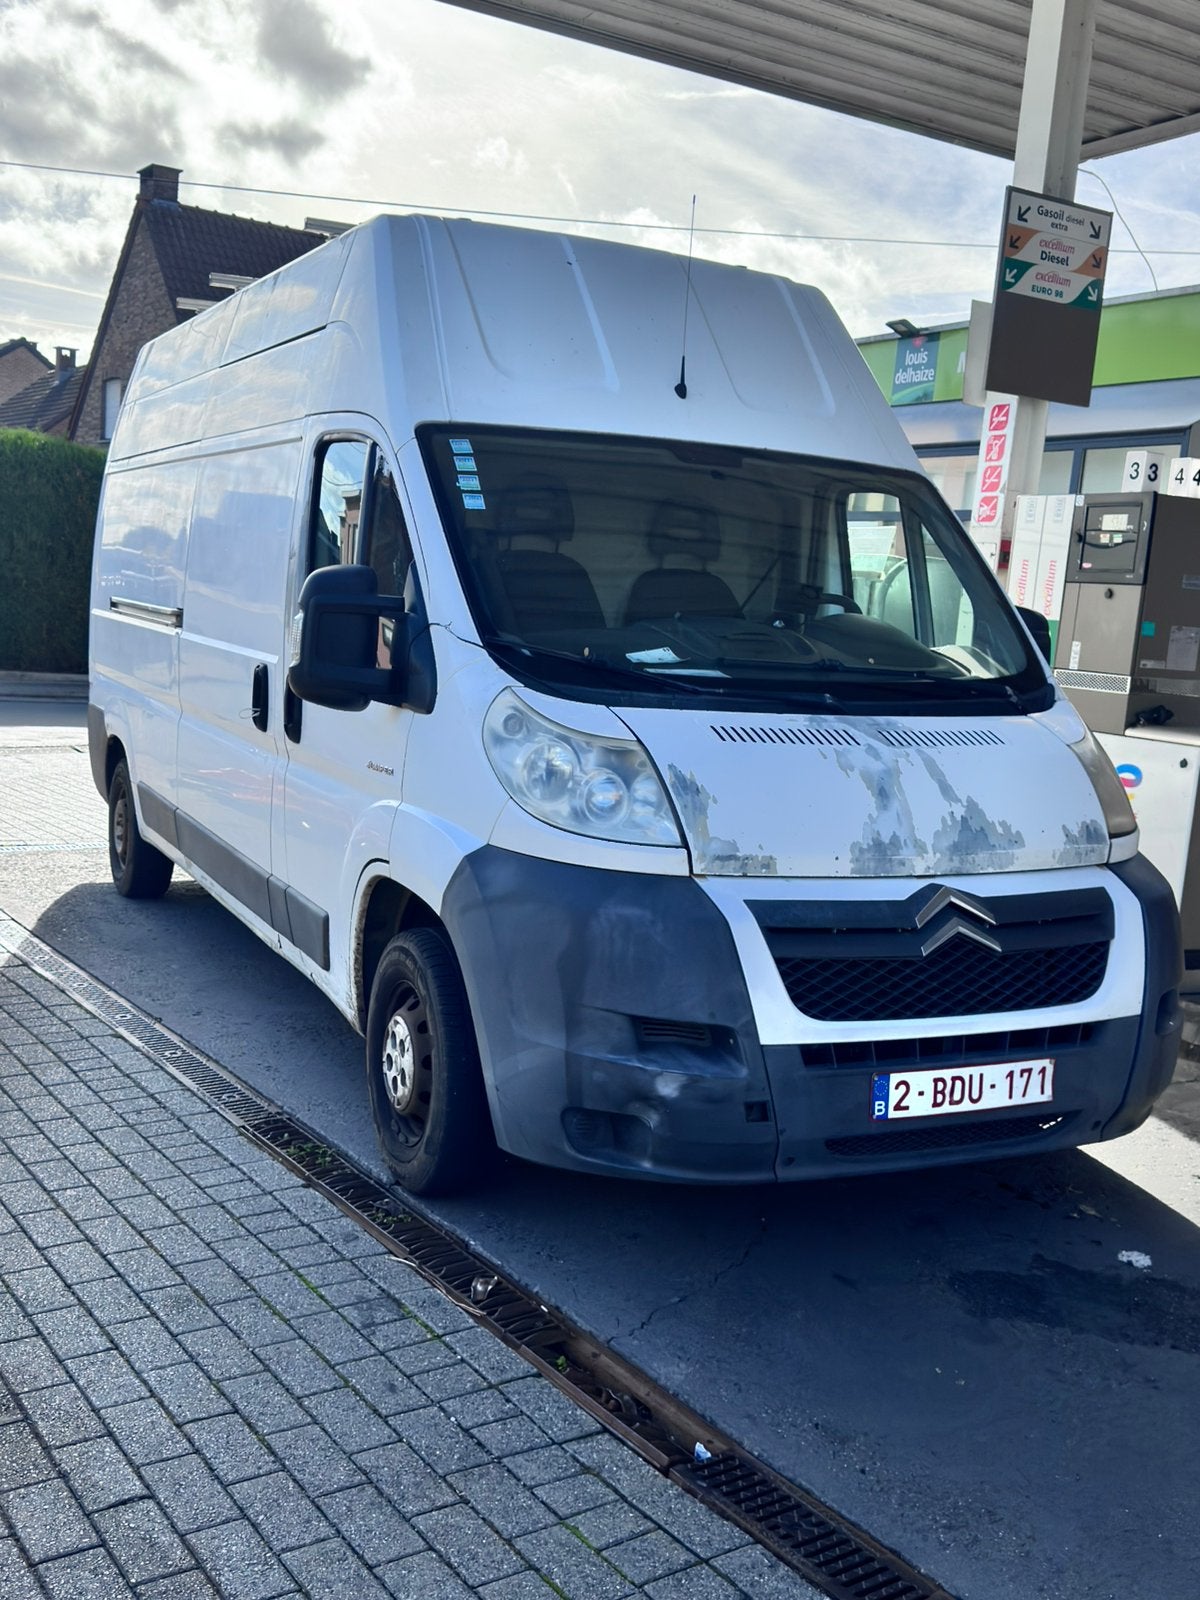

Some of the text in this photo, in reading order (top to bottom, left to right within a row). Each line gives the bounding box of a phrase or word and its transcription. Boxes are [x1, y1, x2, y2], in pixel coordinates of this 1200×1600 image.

[1037, 205, 1085, 226] Gasoil diesel
[1051, 221, 1068, 231] extra
[1039, 239, 1075, 254] excellium
[1040, 250, 1069, 266] Diesel
[1035, 271, 1071, 287] excellium
[1031, 284, 1064, 298] EURO 98
[905, 348, 928, 366] louis
[895, 366, 935, 384] delhaize
[1129, 462, 1159, 482] 3 3
[1174, 468, 1200, 486] 4 4
[1043, 560, 1057, 616] excellium
[893, 1066, 1047, 1112] 2-BDU-171
[874, 1101, 886, 1115] B
